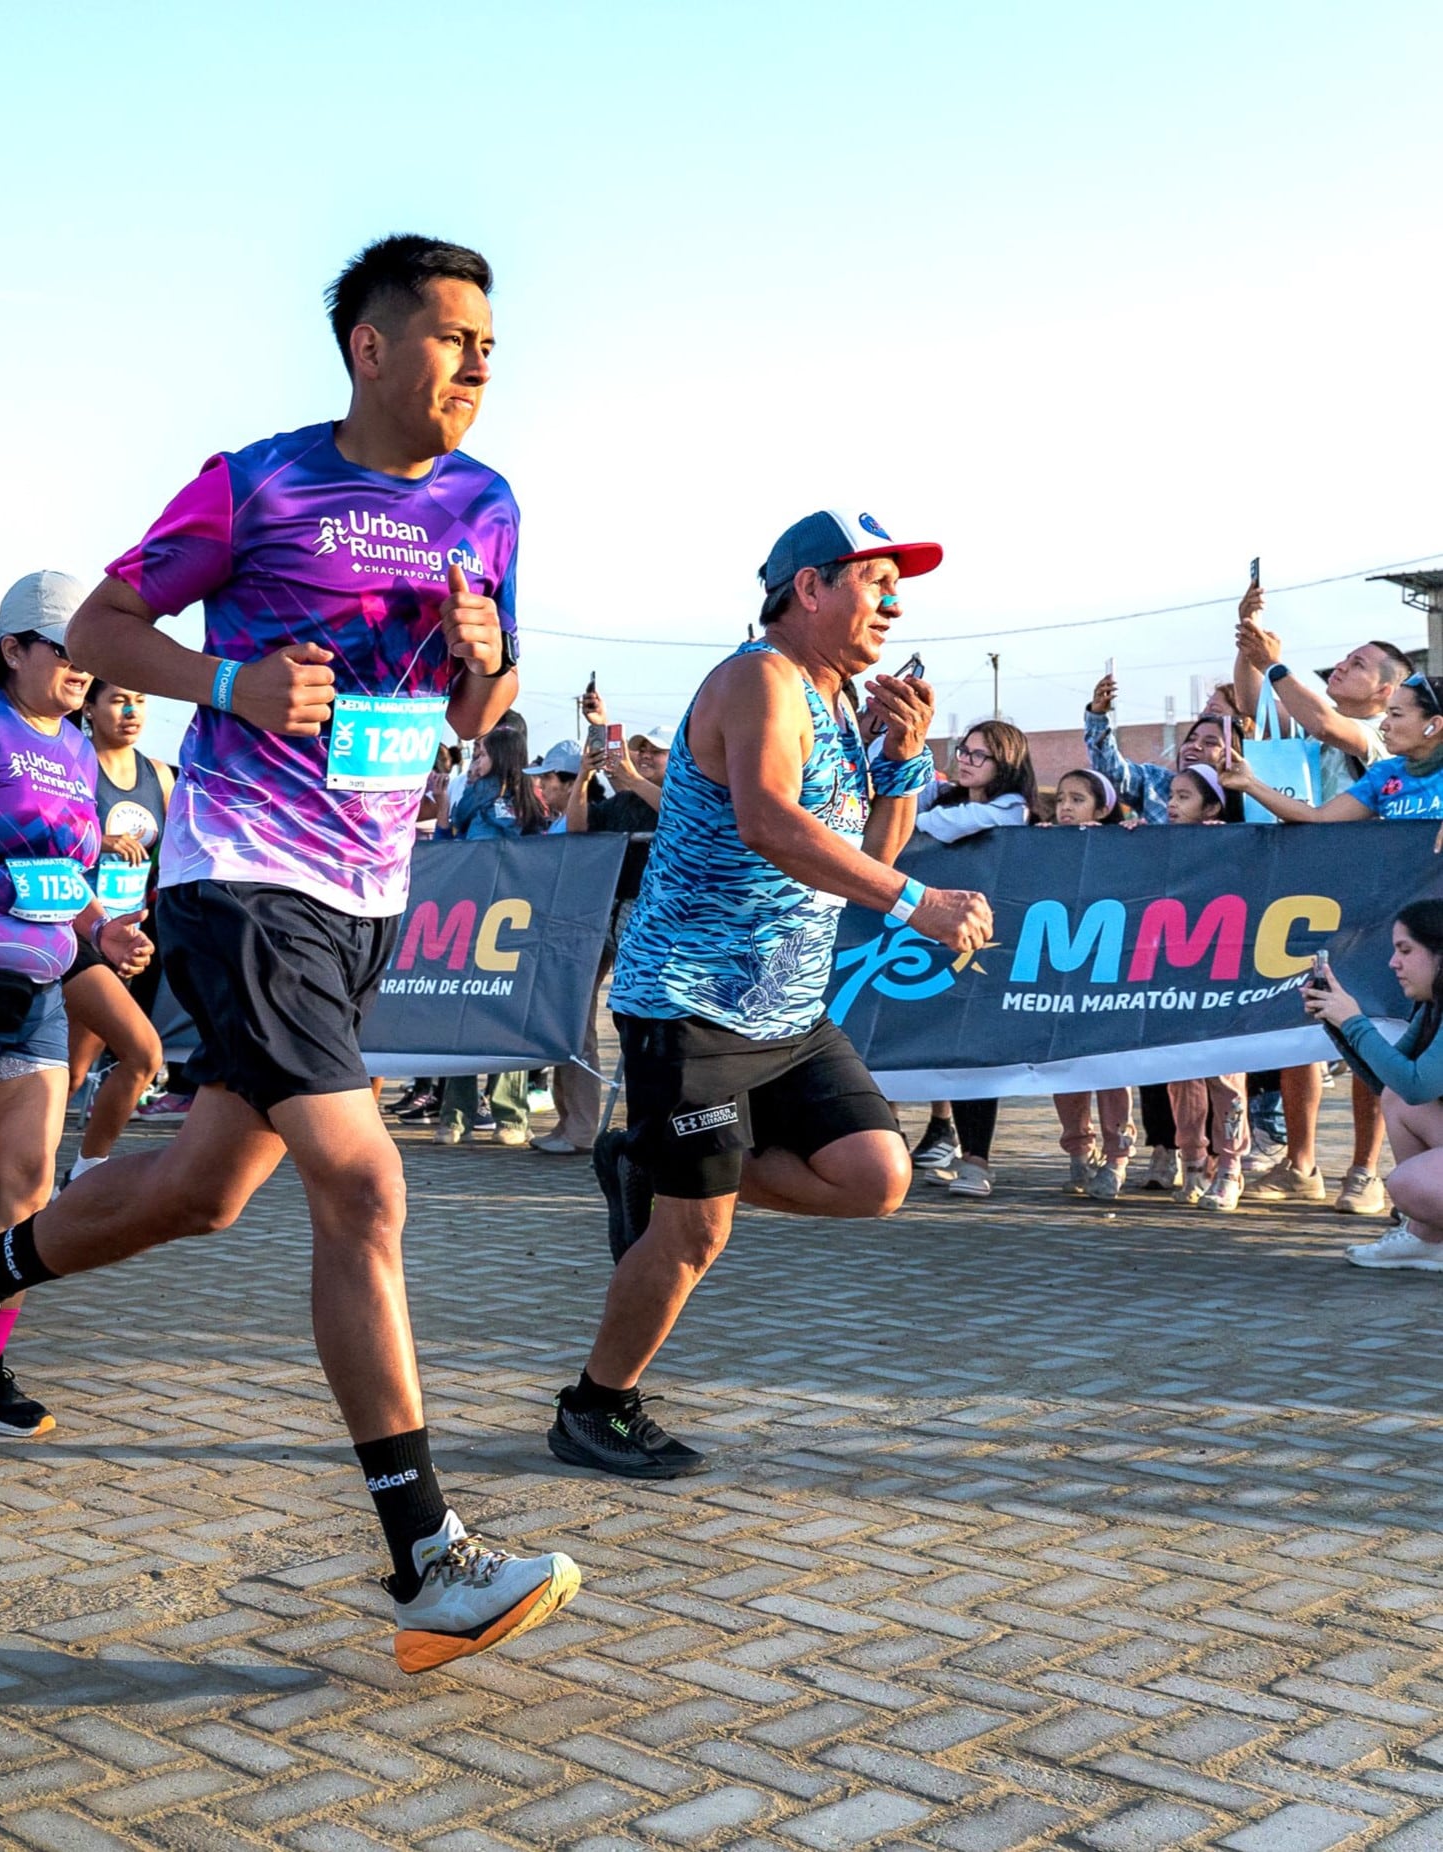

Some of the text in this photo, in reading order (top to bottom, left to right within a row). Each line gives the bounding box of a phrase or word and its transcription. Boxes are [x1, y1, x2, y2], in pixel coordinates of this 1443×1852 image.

[349, 510, 428, 543] Urban
[350, 537, 442, 571] Running
[364, 564, 446, 582] CHACHAPOYAS
[333, 721, 355, 759] 10K
[364, 726, 436, 764] 1200
[26, 750, 67, 777] Urban
[13, 873, 31, 900] 10K
[38, 875, 84, 901] 1136
[388, 898, 532, 972] MC
[1009, 894, 1342, 985] MMC
[438, 979, 460, 995] DE
[461, 976, 514, 996] COLÁN
[1002, 992, 1075, 1014] MEDIA
[1080, 986, 1197, 1014] MARATÓN
[1201, 990, 1234, 1010] DE
[698, 1108, 731, 1121] UNDER
